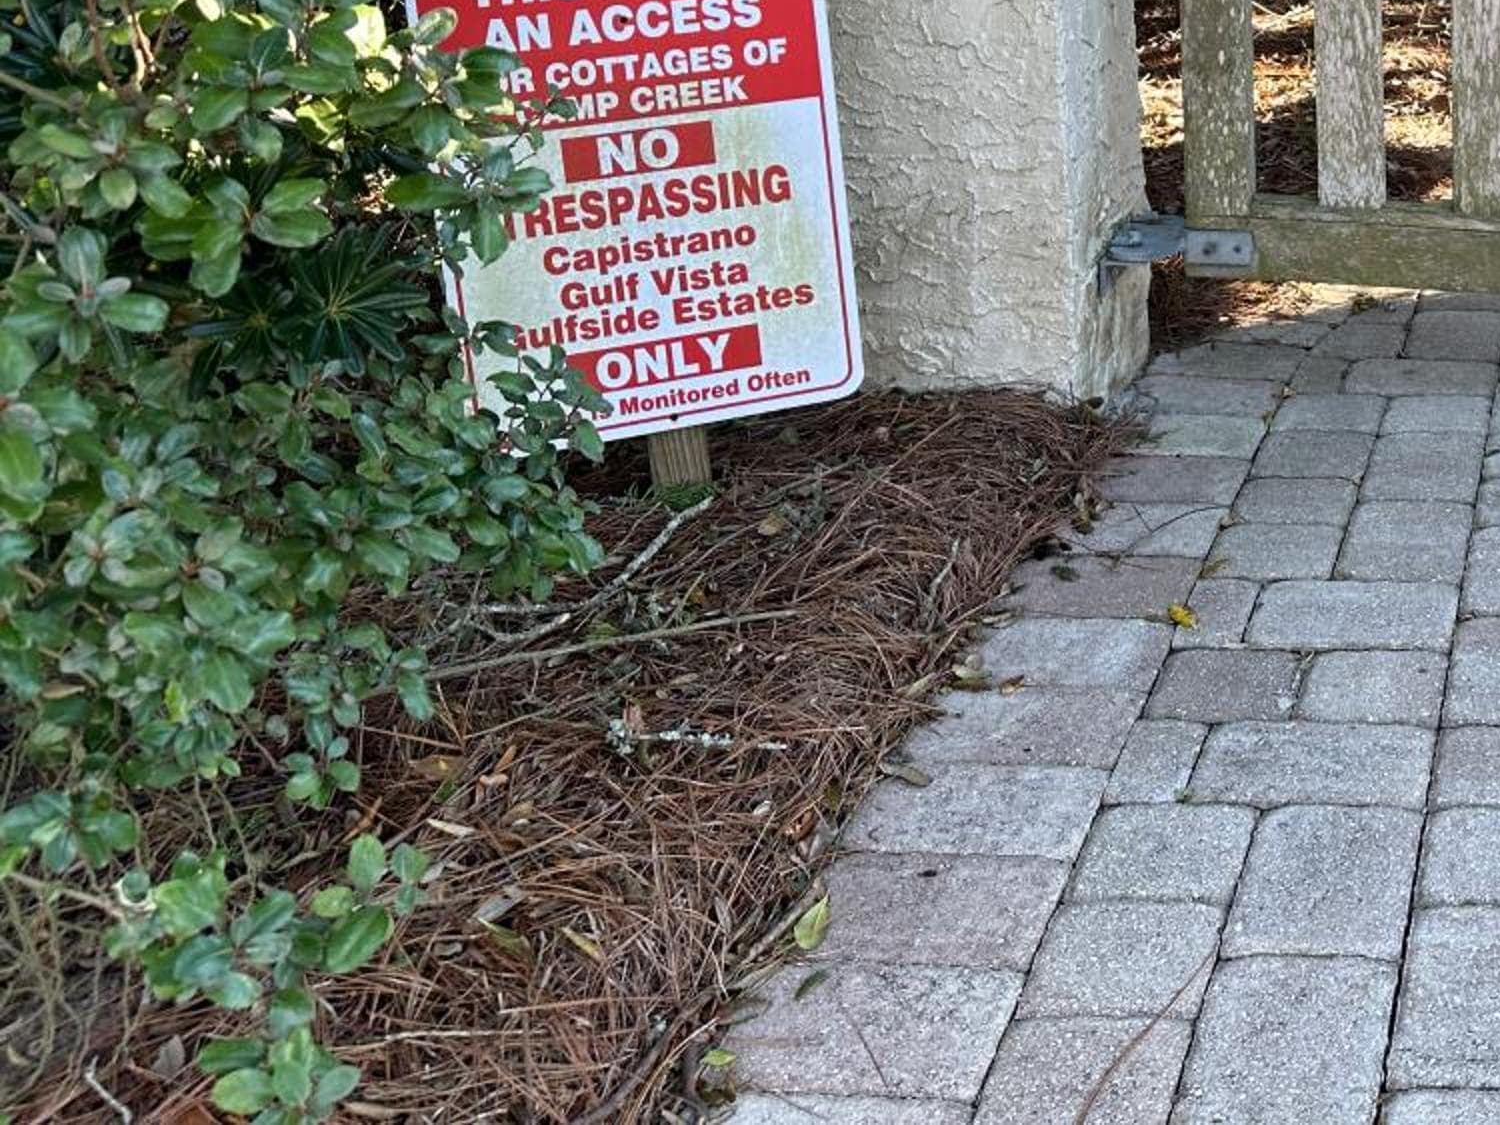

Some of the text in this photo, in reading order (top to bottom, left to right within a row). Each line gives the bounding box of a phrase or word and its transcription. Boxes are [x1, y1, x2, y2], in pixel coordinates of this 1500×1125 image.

[485, 13, 552, 53] AN
[545, 44, 733, 89] COTTAGES
[743, 37, 787, 66] OF
[630, 75, 748, 114] CREEK
[595, 128, 680, 175] NO
[543, 225, 756, 275] Capistrano
[560, 261, 749, 310] Gulf Vista
[673, 283, 814, 324] Estates
[595, 334, 731, 388] ONLY
[619, 379, 740, 416] Monitored
[747, 370, 811, 392] Often
